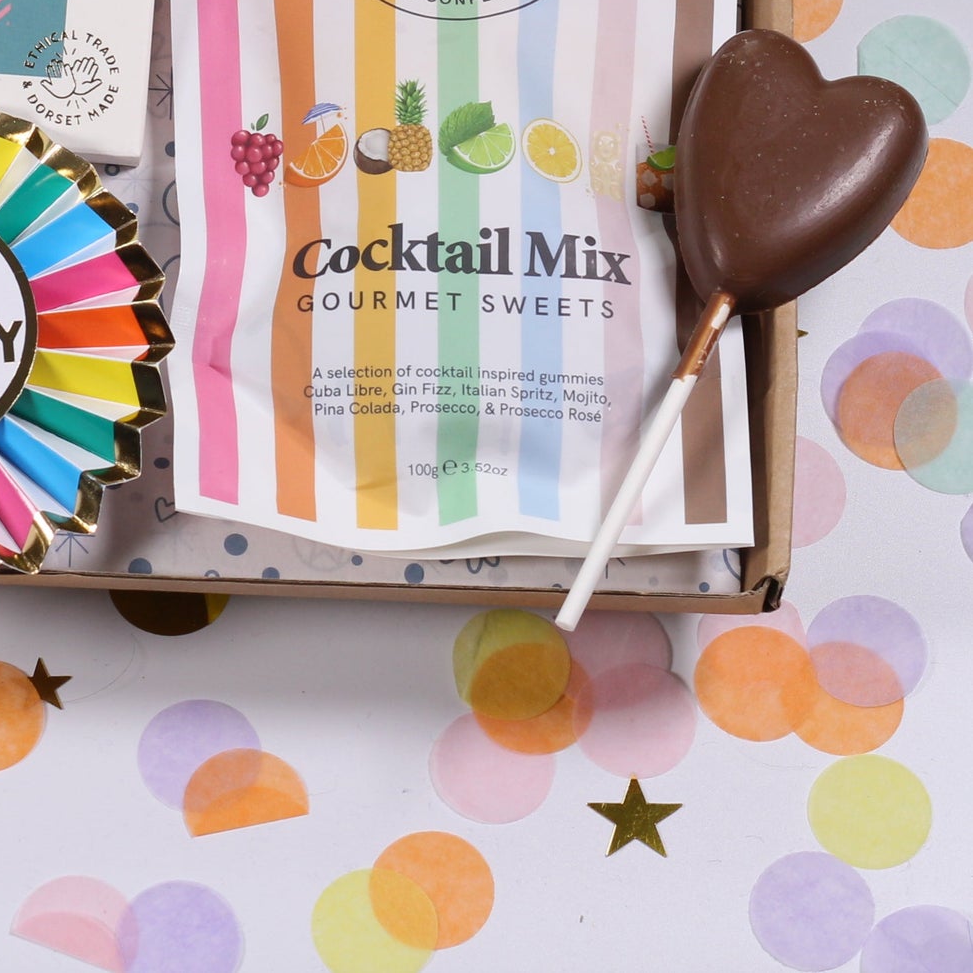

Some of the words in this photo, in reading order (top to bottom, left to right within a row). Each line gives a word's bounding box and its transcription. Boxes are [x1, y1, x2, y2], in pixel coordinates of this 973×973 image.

[24, 30, 78, 69] ETHICAL
[85, 32, 120, 75] TRADE
[27, 94, 81, 126] DORSET
[87, 84, 119, 122] MADE
[292, 222, 513, 279] Cocktail
[523, 230, 632, 286] Mix
[297, 290, 462, 313] GOURMET
[481, 293, 615, 319] SWEETS
[312, 367, 323, 379] A
[327, 366, 392, 379] selection
[396, 365, 412, 378] of
[415, 365, 473, 379] cocktail
[477, 367, 535, 383] inspired
[539, 370, 604, 387] gummies
[303, 384, 342, 398] Cuba
[345, 383, 387, 398] Libre,
[391, 383, 417, 396] Gin
[422, 383, 457, 398] Fizz,
[461, 383, 507, 398] Italian
[510, 385, 558, 403] Spritz,
[562, 390, 612, 406] Mojito,
[314, 403, 345, 416] Pina
[349, 401, 405, 416] Colada,
[410, 400, 480, 417] Prosecco,
[484, 402, 496, 415] &
[499, 403, 564, 420] Prosecco
[568, 408, 602, 423] Rosé
[407, 463, 439, 480] 100g
[460, 461, 508, 477] 3.52oz
